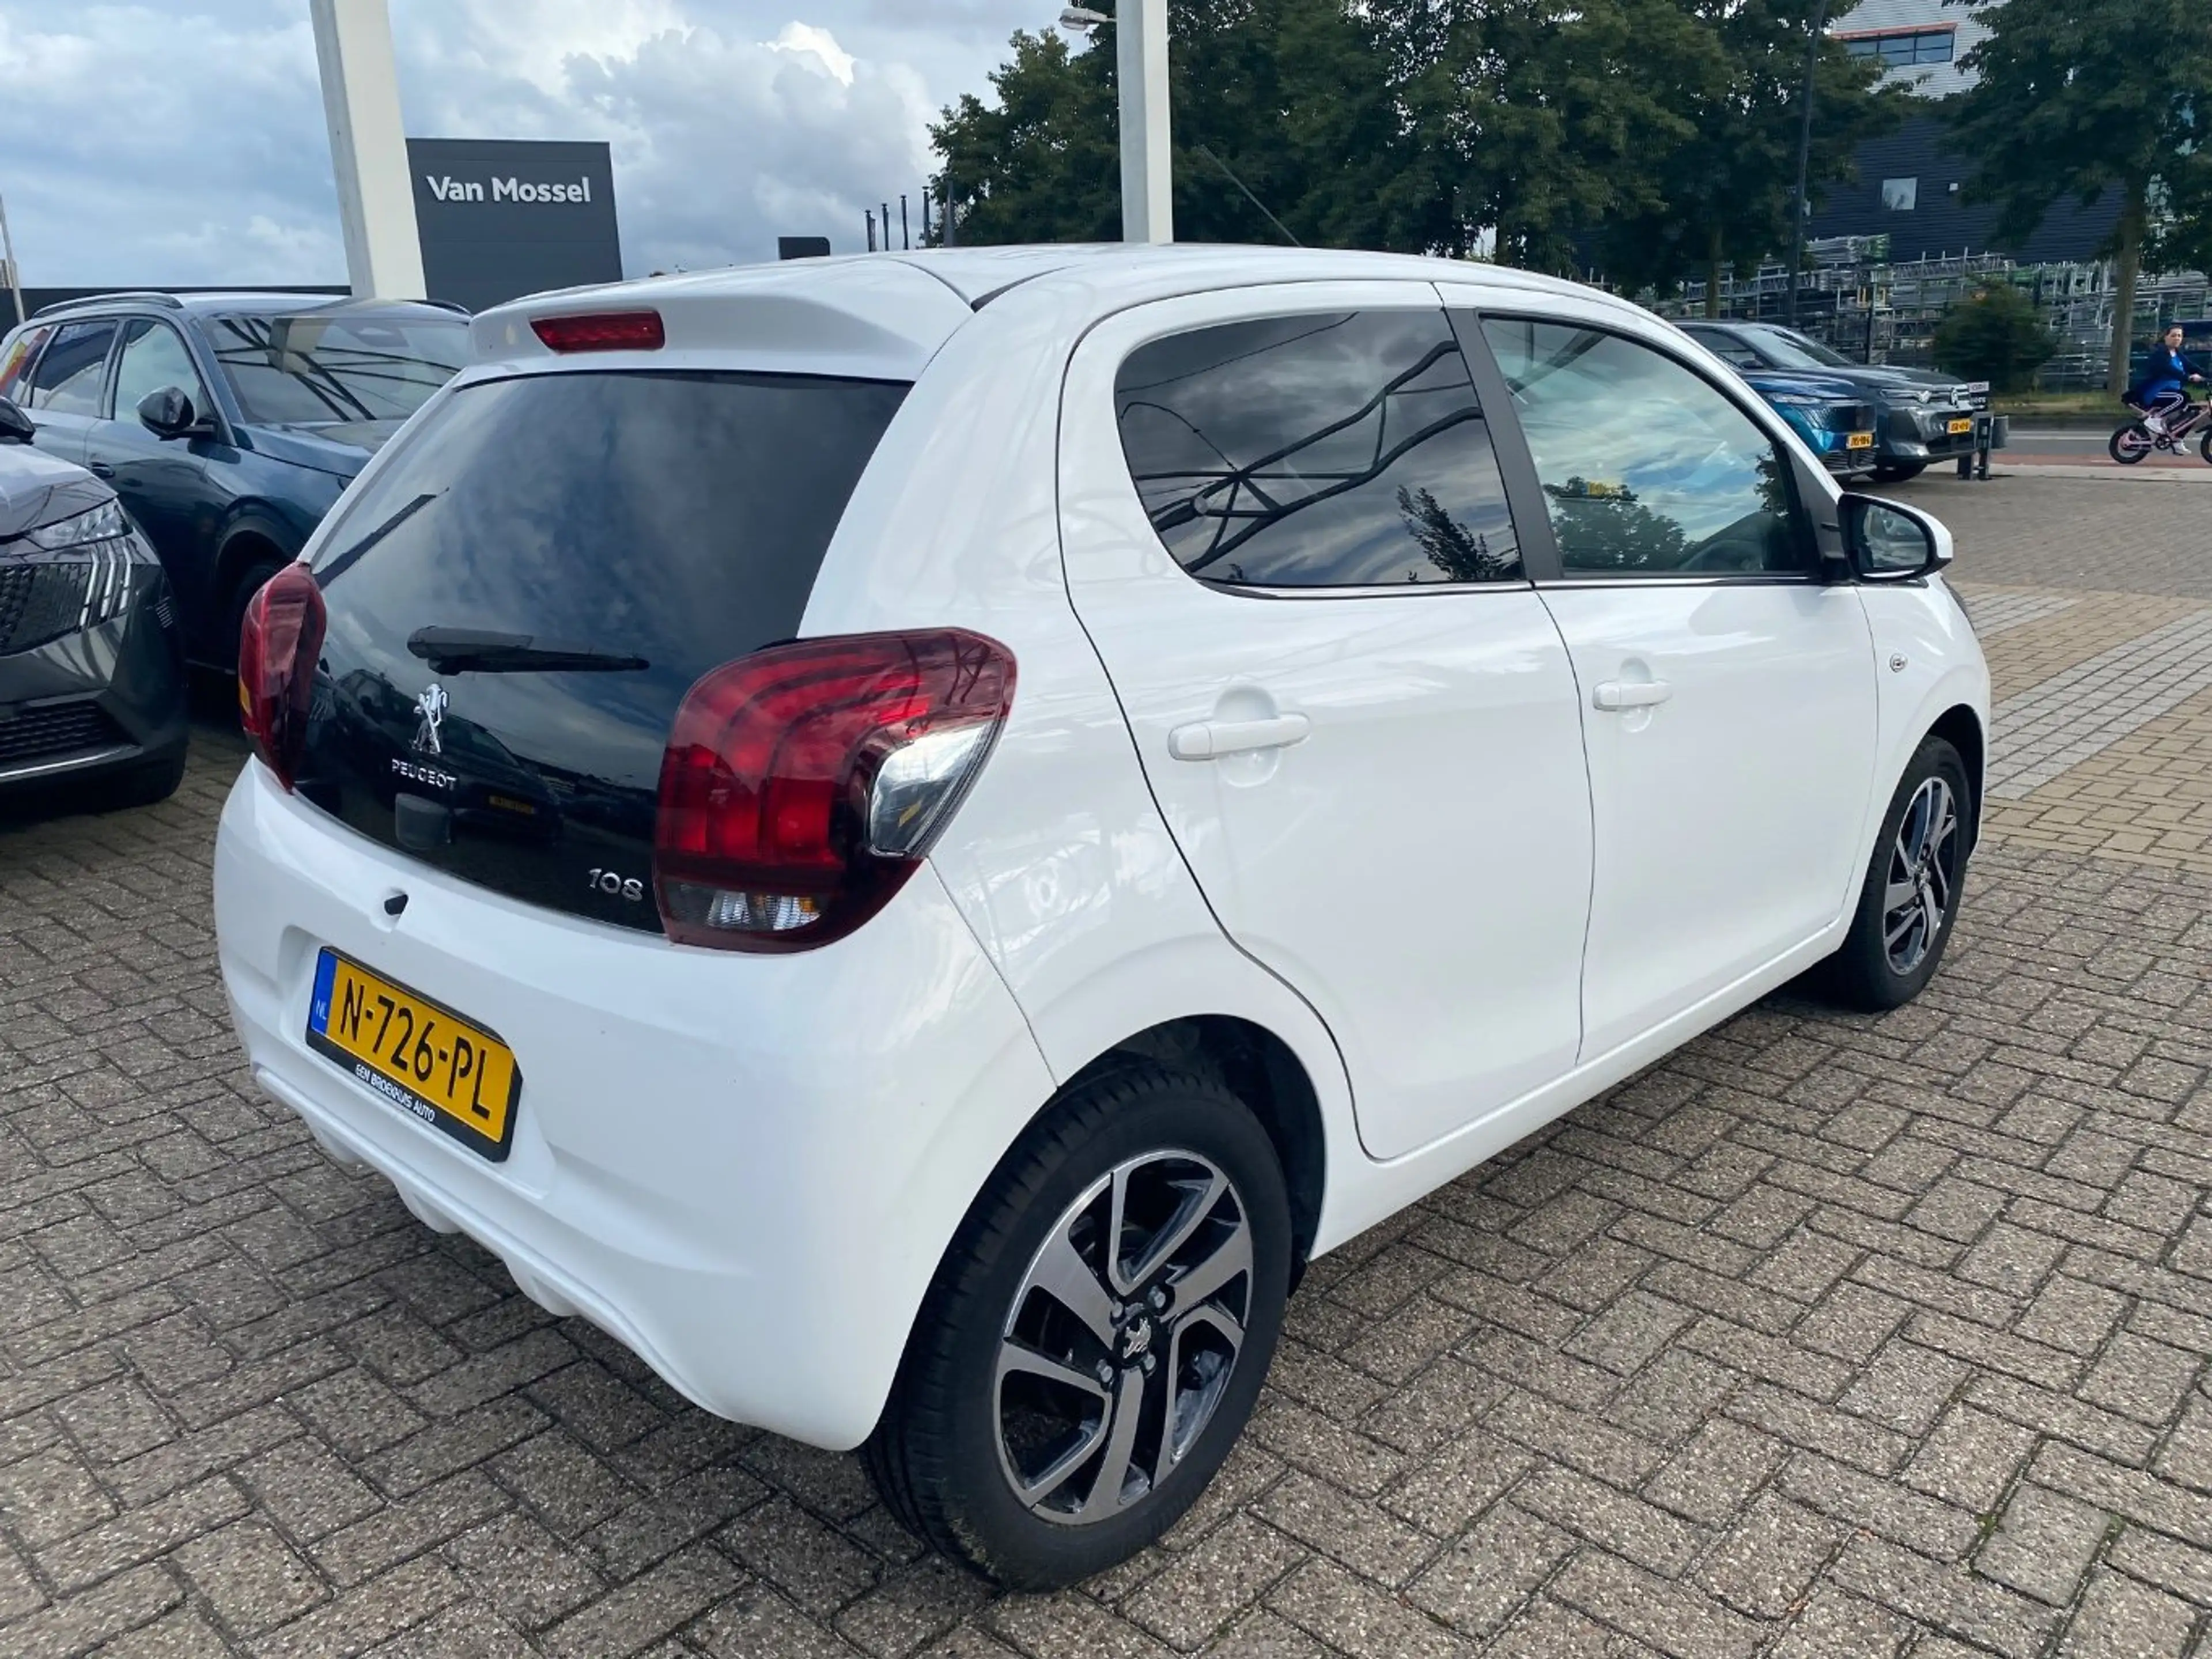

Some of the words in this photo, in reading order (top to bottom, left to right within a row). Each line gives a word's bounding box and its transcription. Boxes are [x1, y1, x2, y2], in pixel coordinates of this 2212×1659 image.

[426, 175, 483, 201] Van
[491, 176, 591, 202] Mossel
[391, 758, 457, 791] PEUGEOT
[589, 868, 643, 902] 108
[340, 976, 490, 1120] N-726-PL
[413, 1099, 436, 1122] AUTO
